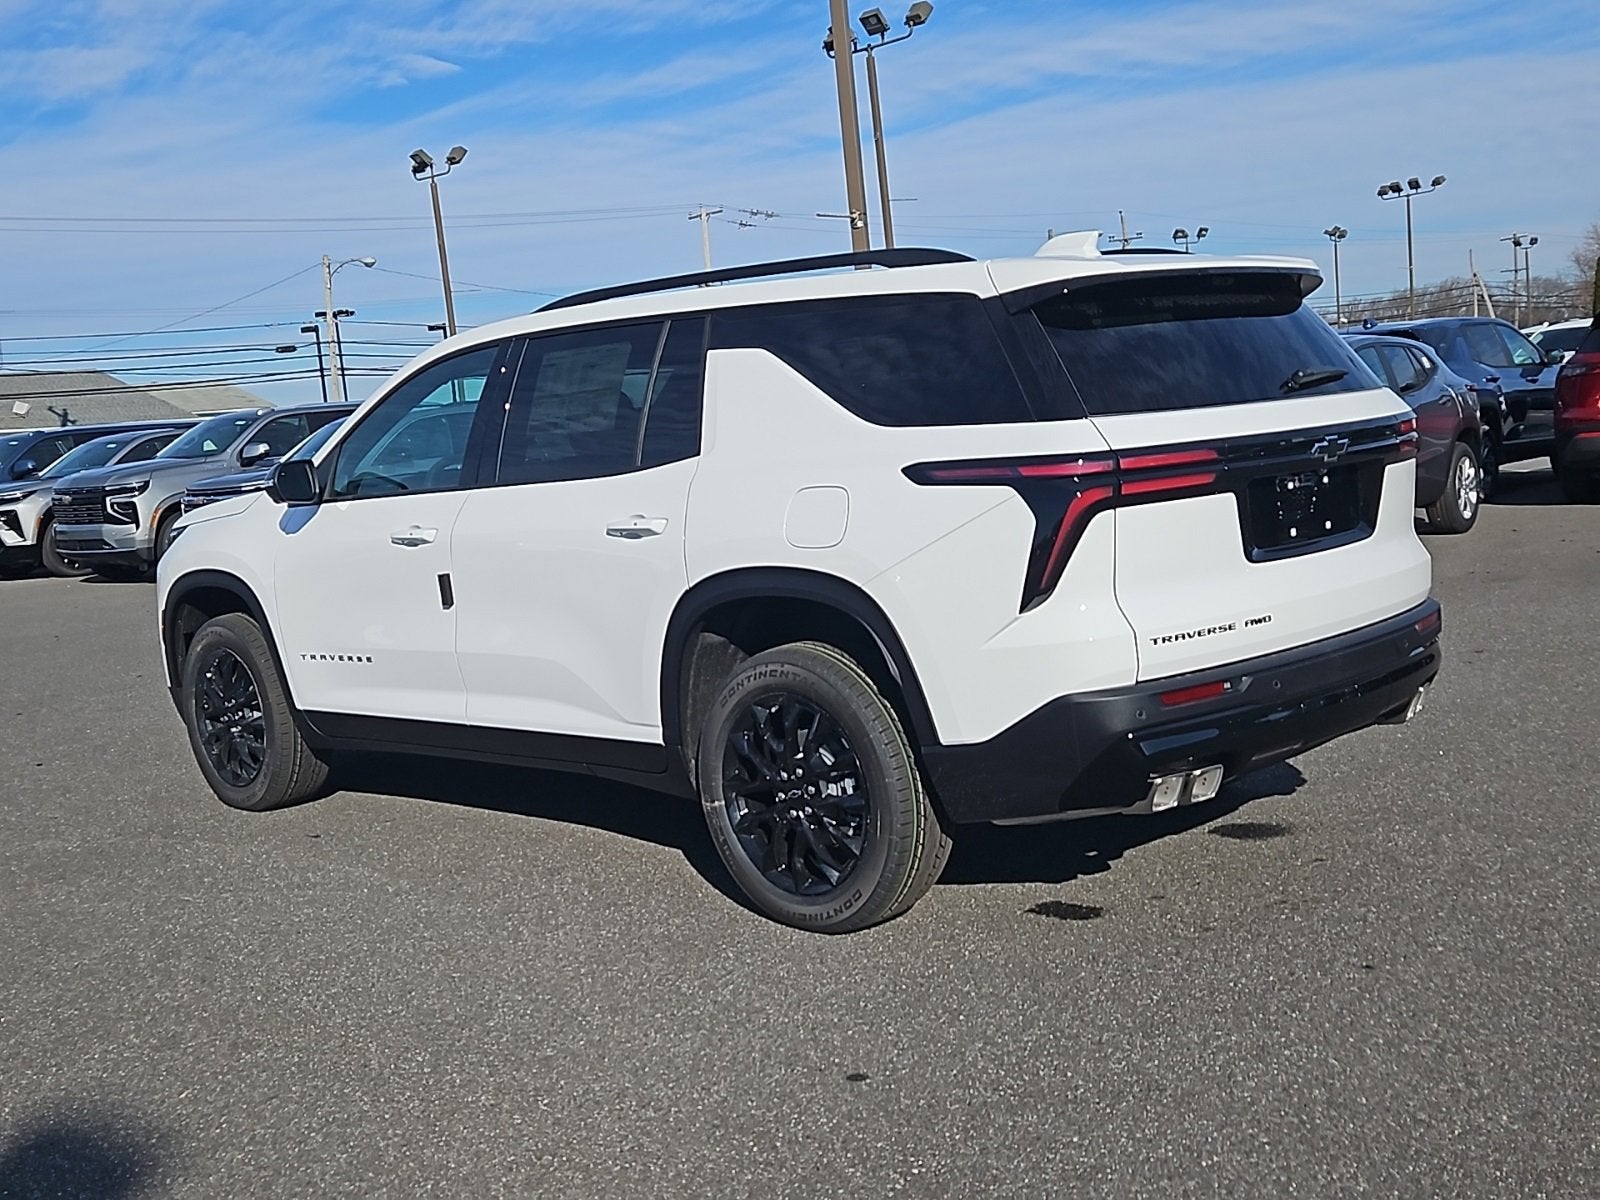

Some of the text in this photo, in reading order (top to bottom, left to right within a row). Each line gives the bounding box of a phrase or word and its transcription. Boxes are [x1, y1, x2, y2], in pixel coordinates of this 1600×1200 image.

[1149, 614, 1272, 646] TRAVERSE AWD
[300, 654, 373, 663] TRAVERSE
[720, 669, 815, 709] CONTINENTA
